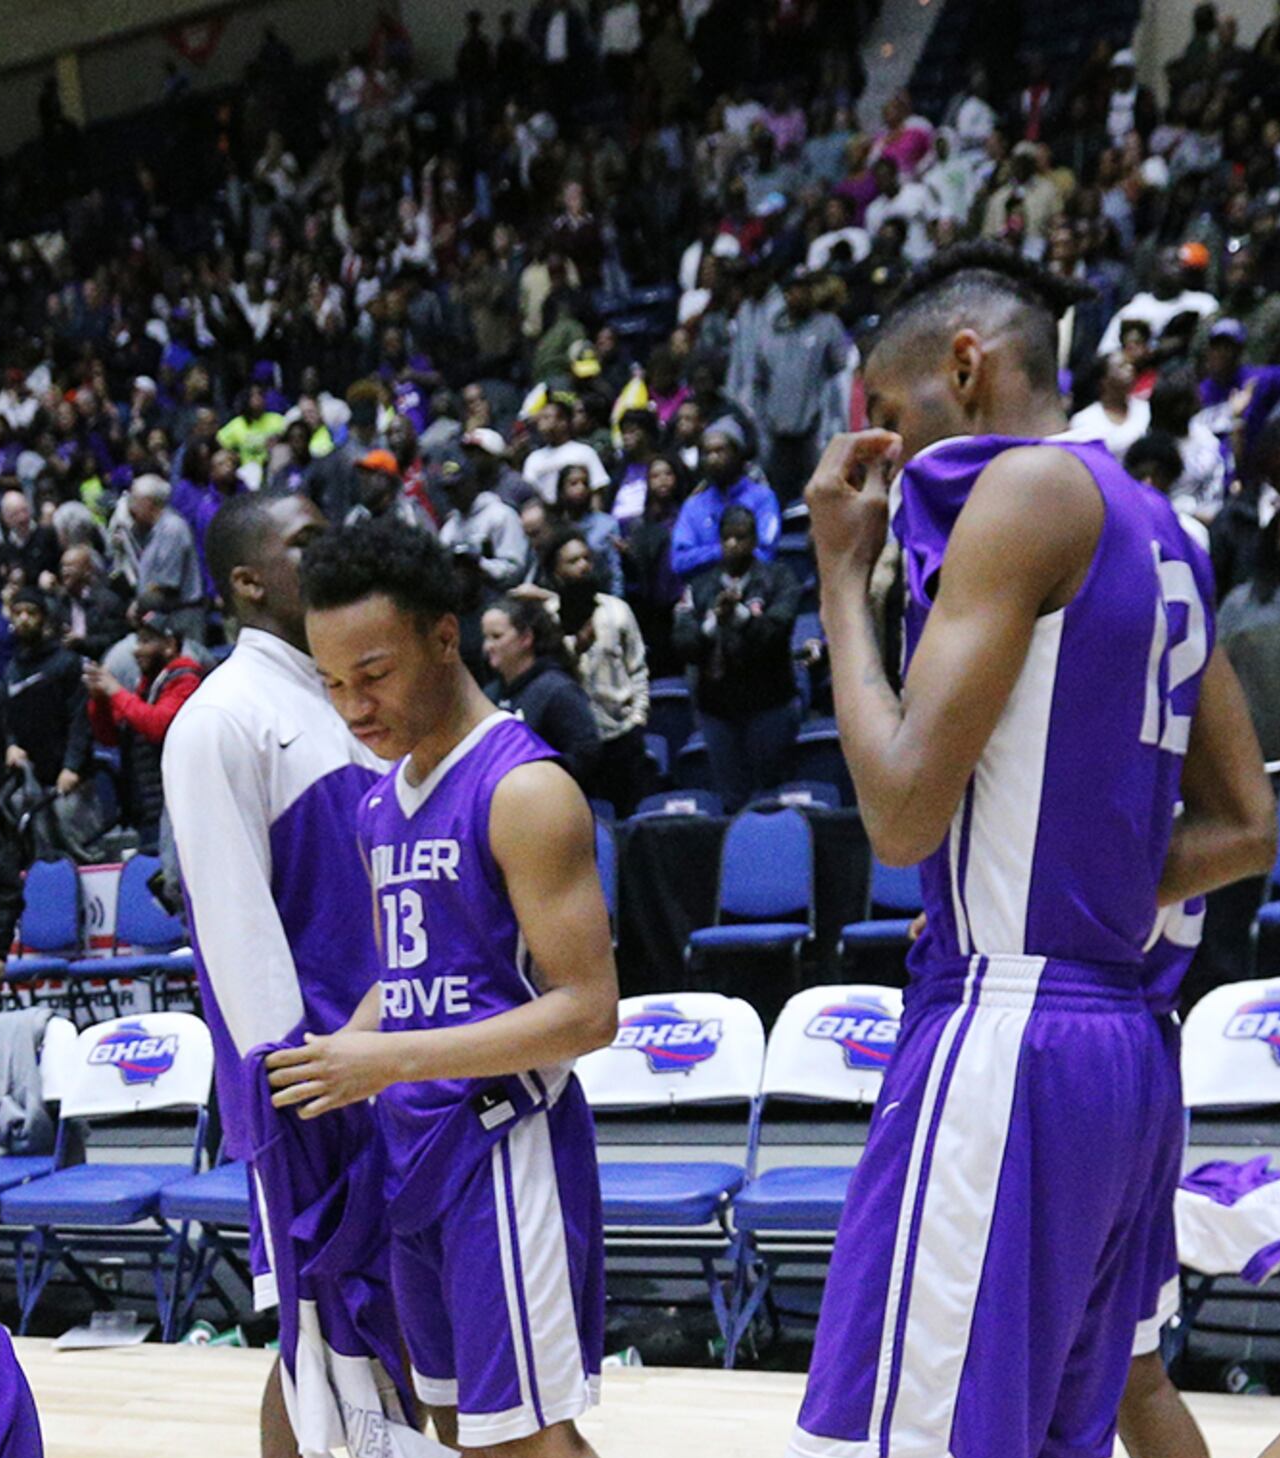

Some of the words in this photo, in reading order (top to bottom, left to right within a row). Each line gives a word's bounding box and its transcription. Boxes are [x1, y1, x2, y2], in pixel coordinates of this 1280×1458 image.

[1138, 541, 1209, 755] 12
[381, 887, 429, 969] 13
[376, 976, 471, 1019] ROVE
[613, 1019, 723, 1049] GHSA
[805, 1015, 900, 1042] GHS
[86, 1034, 179, 1065] GHSA
